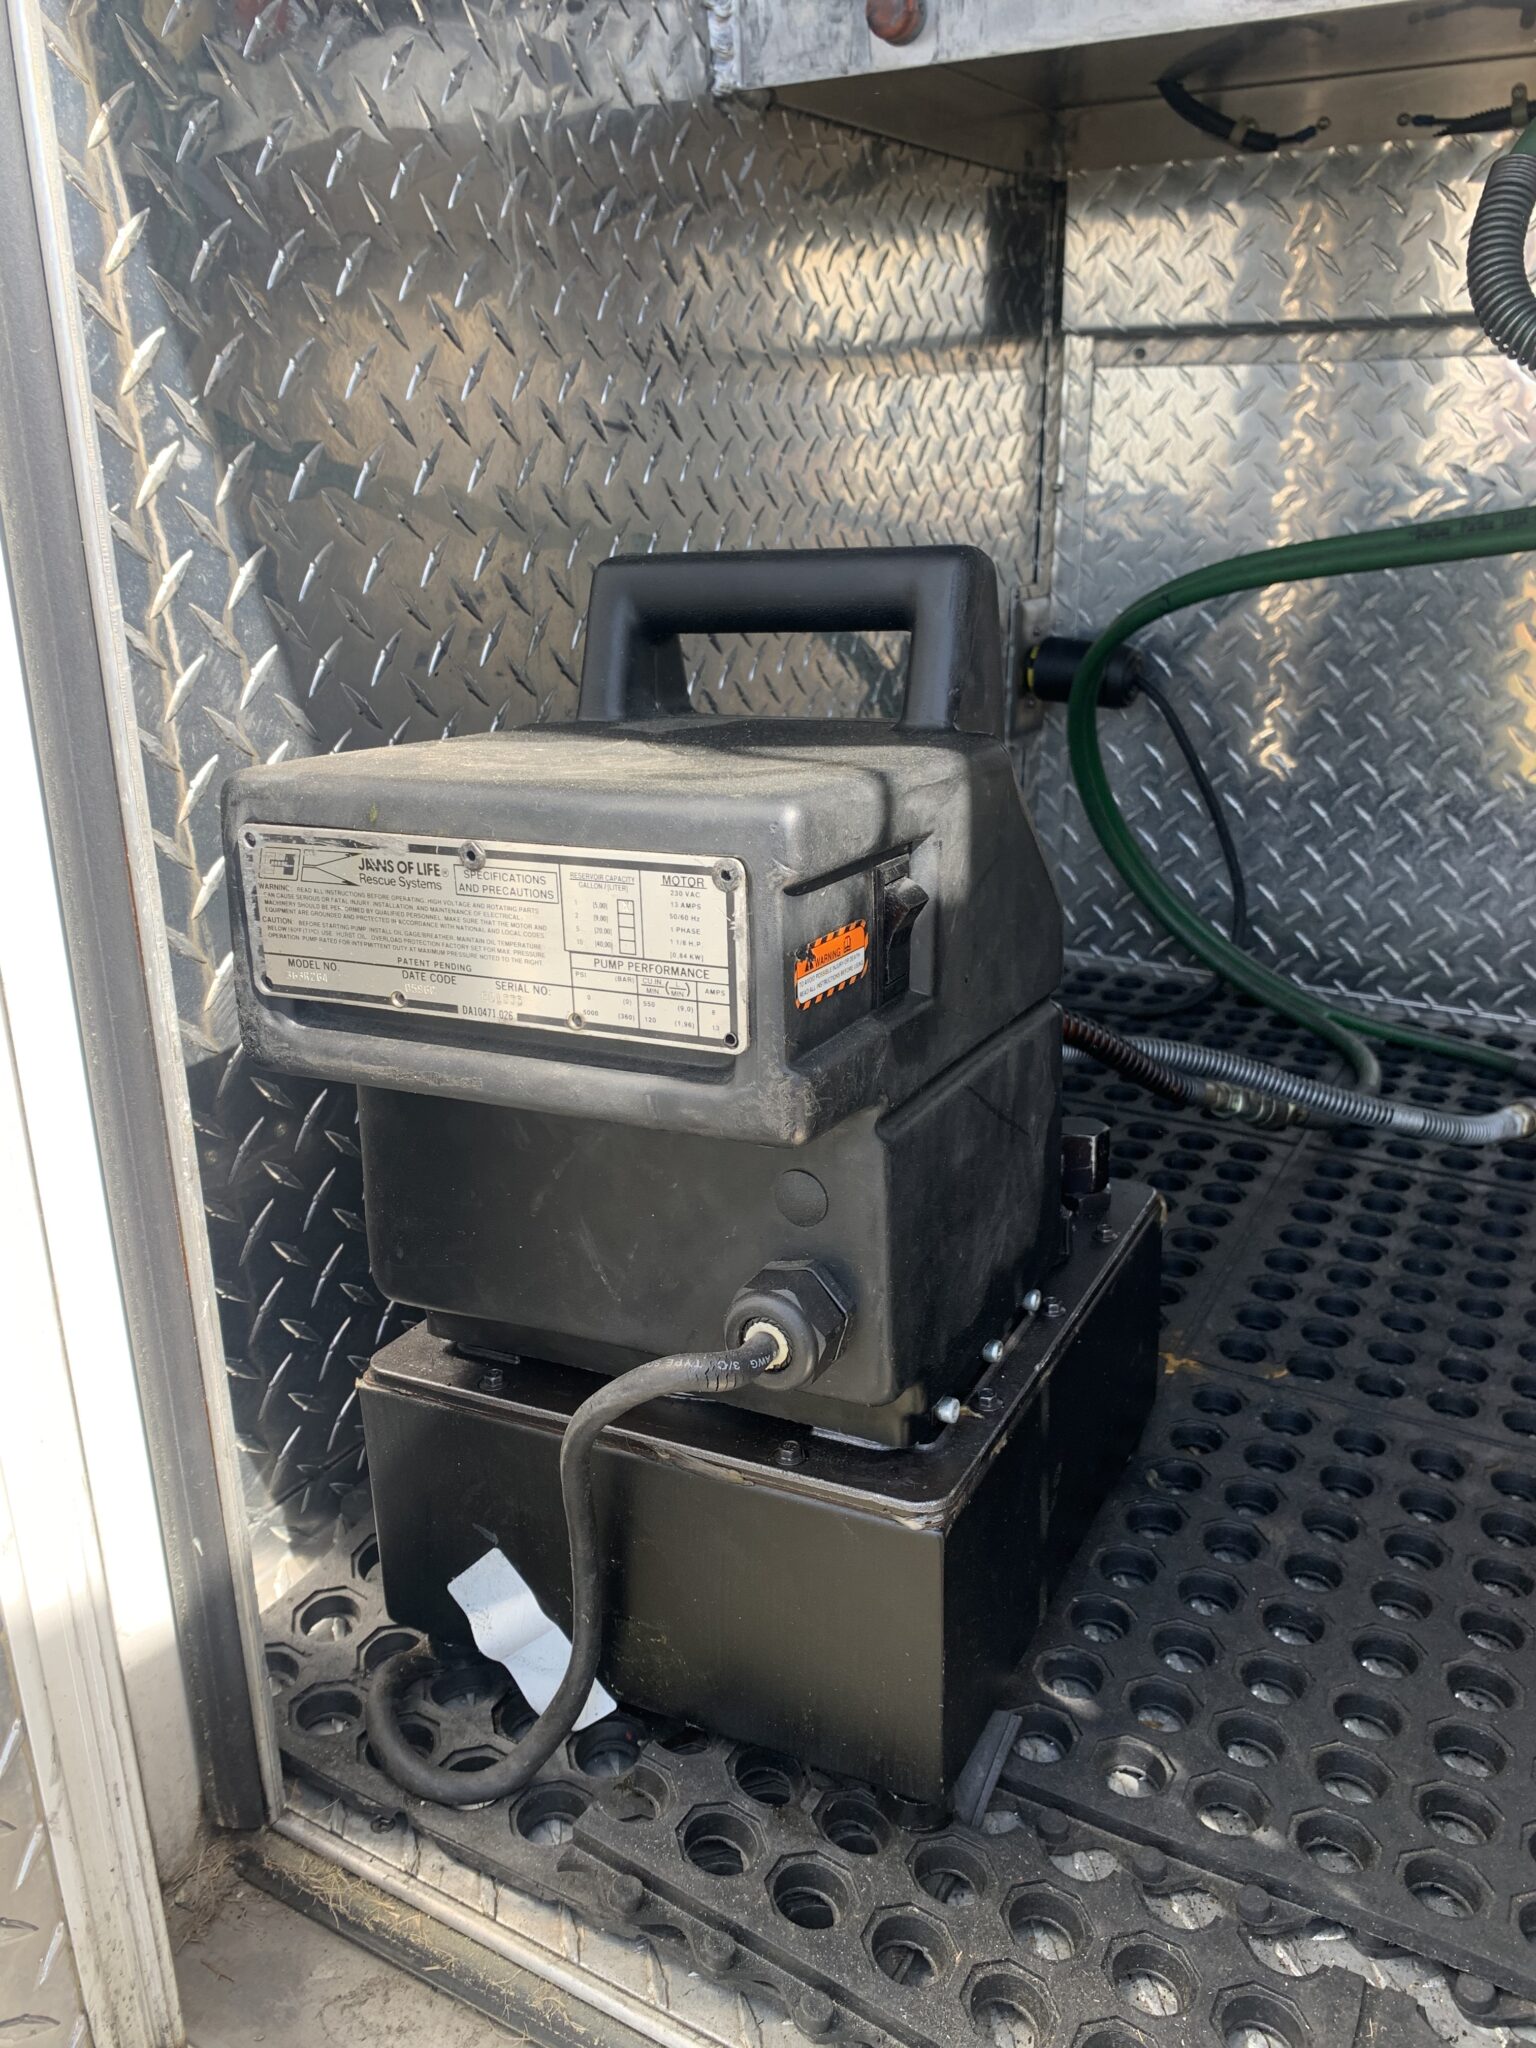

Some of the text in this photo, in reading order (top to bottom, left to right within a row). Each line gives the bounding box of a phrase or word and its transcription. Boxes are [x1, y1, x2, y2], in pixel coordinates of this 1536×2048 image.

[358, 858, 394, 873] JAWS
[397, 861, 414, 874] OF
[359, 873, 443, 893] Rescue Systems
[464, 870, 546, 885] SPECIFICATIONS
[605, 875, 635, 884] CAPACITY
[662, 875, 705, 888] MOTOR
[459, 883, 554, 900] AND PRECAUTIONS
[680, 902, 702, 910] AMPS
[676, 927, 701, 935] PHASE
[287, 958, 320, 970] MODEL
[816, 947, 841, 967] WARNING
[397, 957, 472, 973] PATENT PENDING
[594, 959, 710, 980] PUMP PERFORMANCE
[402, 970, 457, 985] DATE CODE
[495, 981, 529, 994] SERIAL
[665, 1358, 703, 1368] TYPE
[717, 1360, 740, 1370] 3/C
